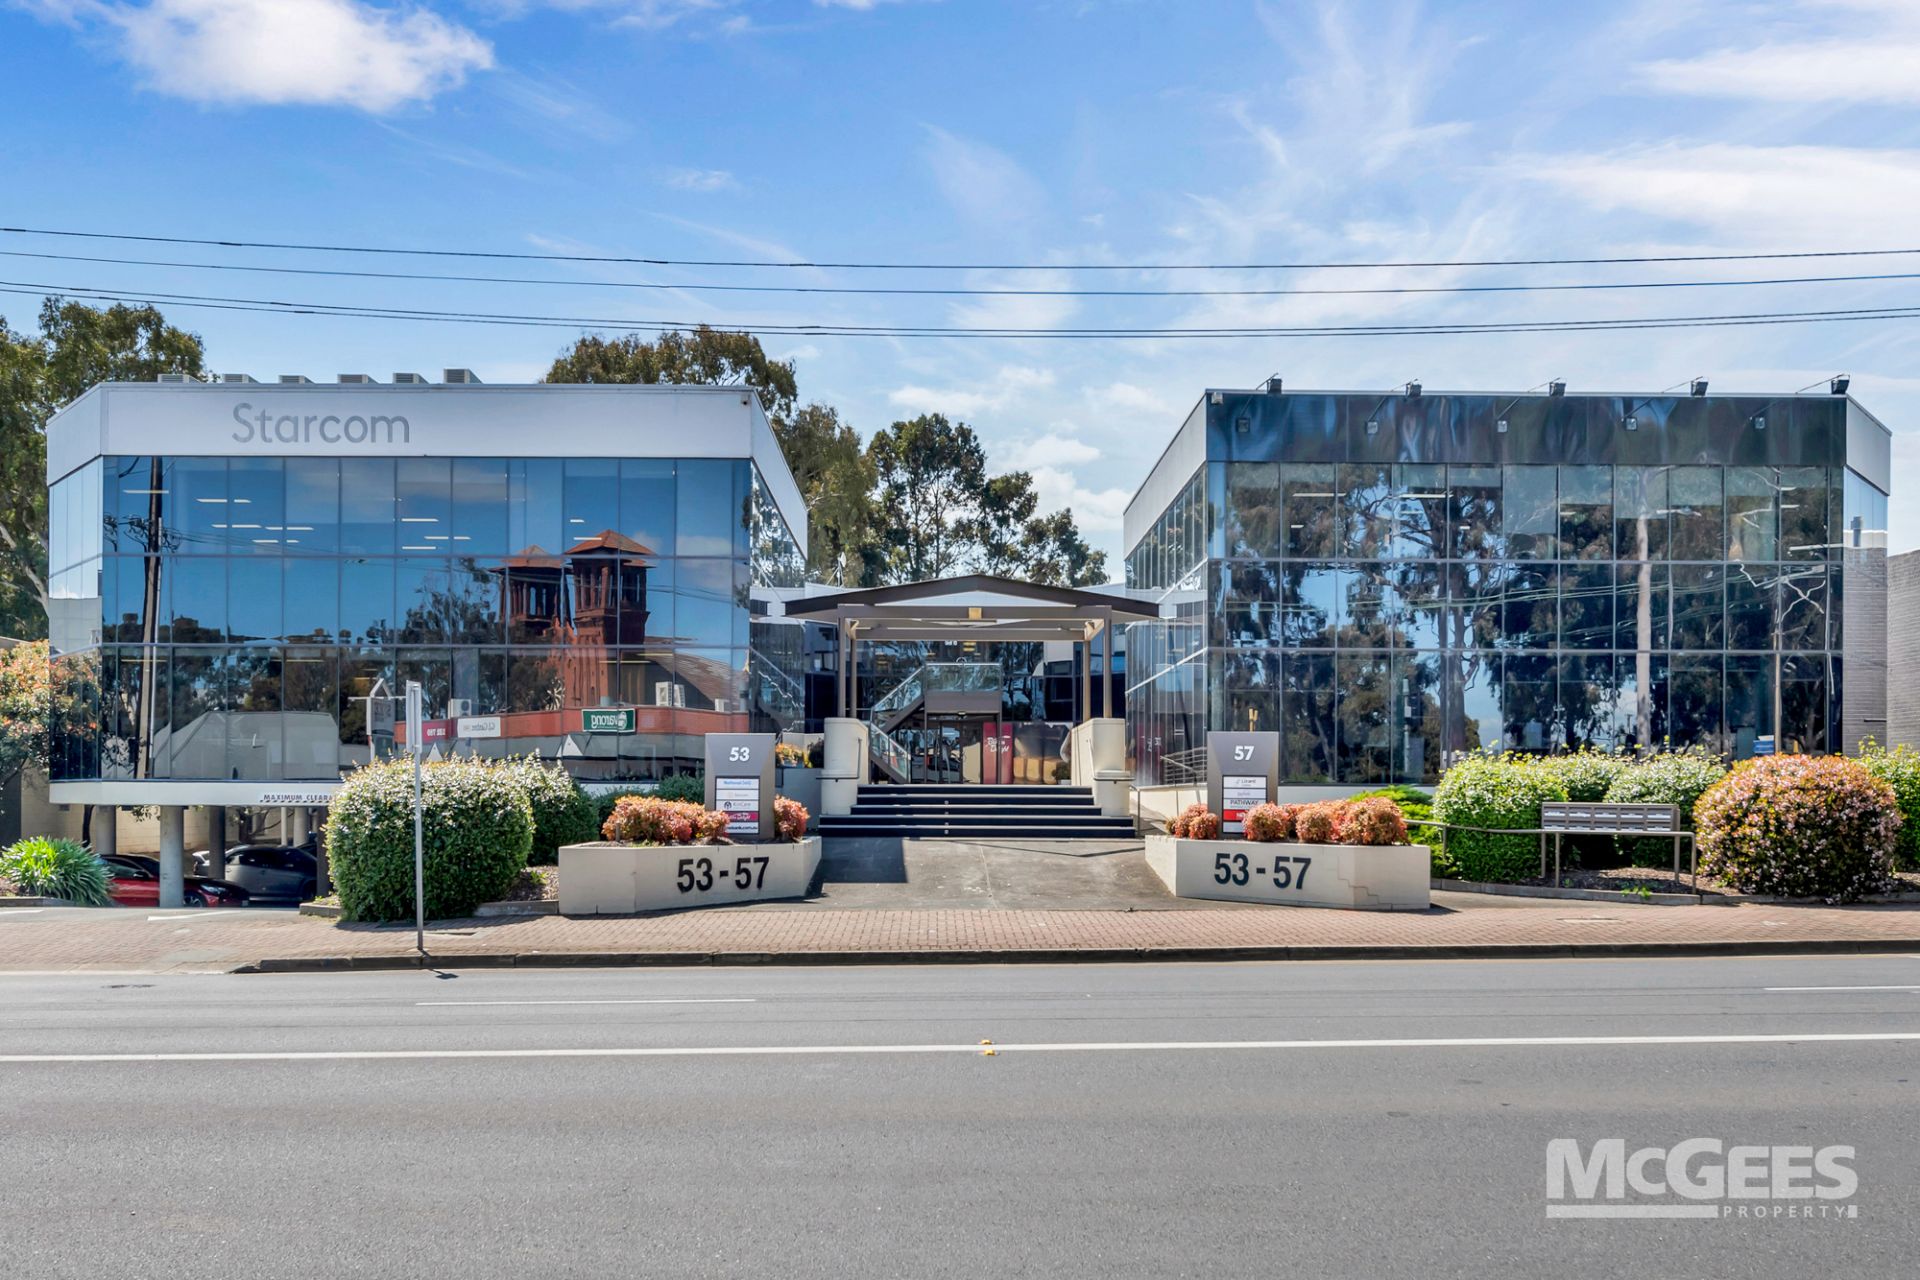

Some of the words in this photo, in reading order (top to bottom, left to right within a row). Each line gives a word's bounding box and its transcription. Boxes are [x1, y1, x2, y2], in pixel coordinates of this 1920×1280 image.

[231, 402, 410, 444] Starcom
[729, 746, 750, 762] 53
[1234, 745, 1255, 761] 57
